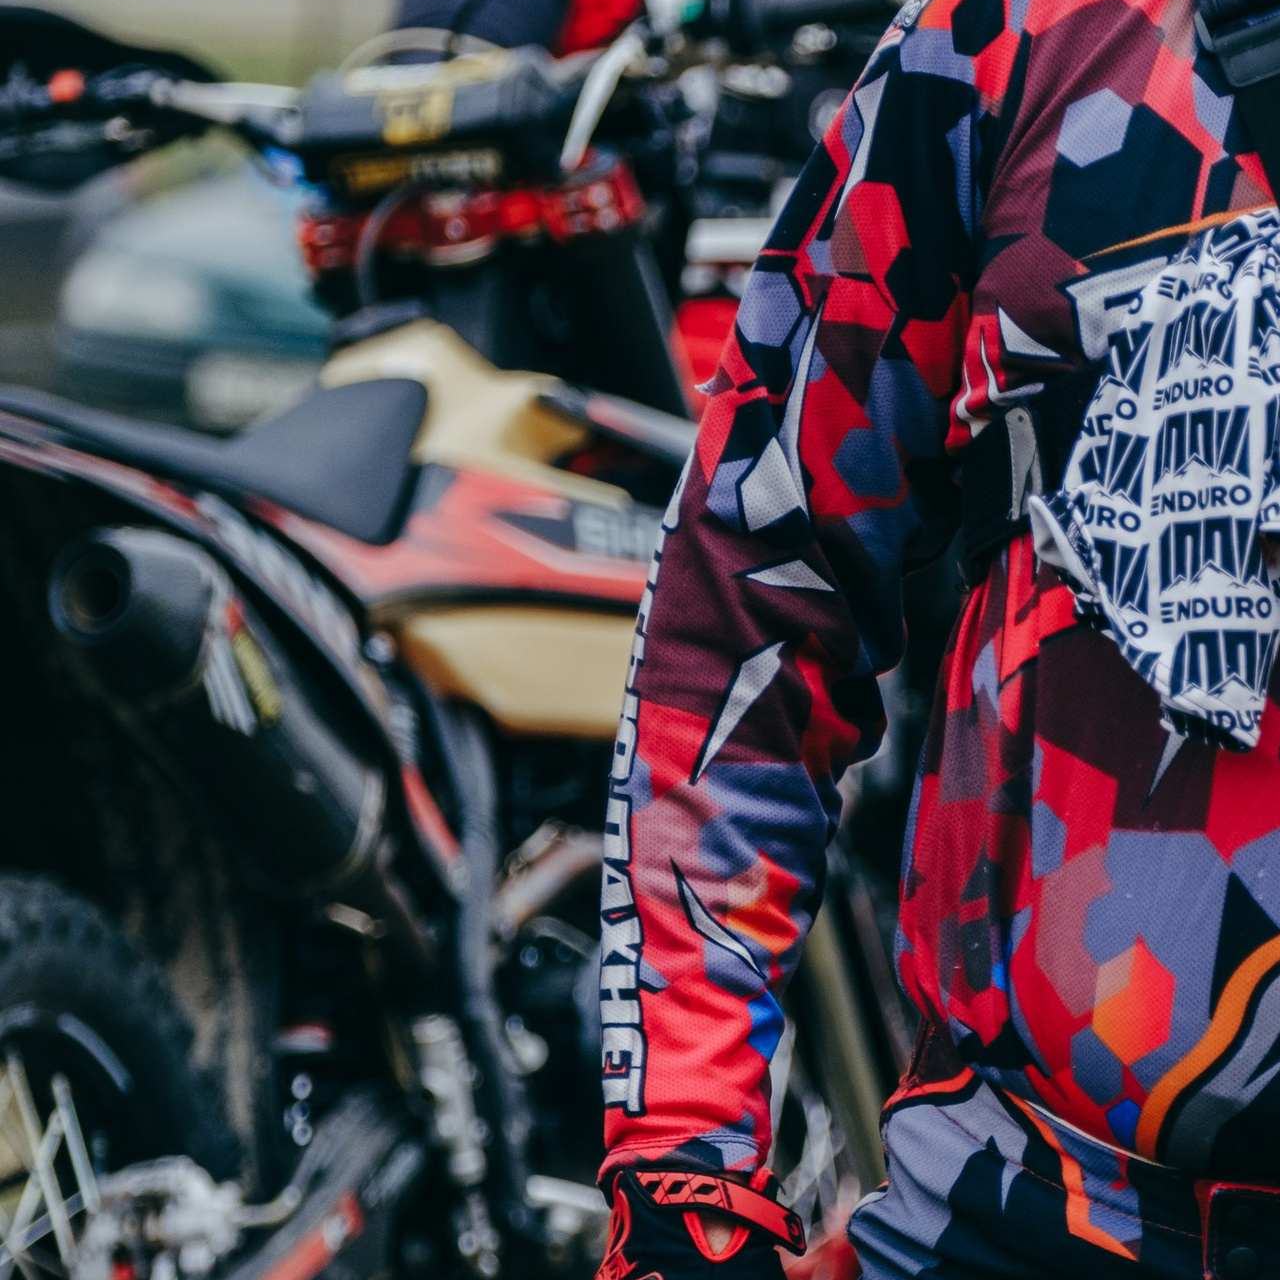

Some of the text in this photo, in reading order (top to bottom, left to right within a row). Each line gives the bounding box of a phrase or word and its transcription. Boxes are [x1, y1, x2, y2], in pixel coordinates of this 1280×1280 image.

[1152, 373, 1234, 411] ENDURO
[1150, 483, 1251, 517] ENDURO
[1160, 595, 1274, 624] ENDURO
